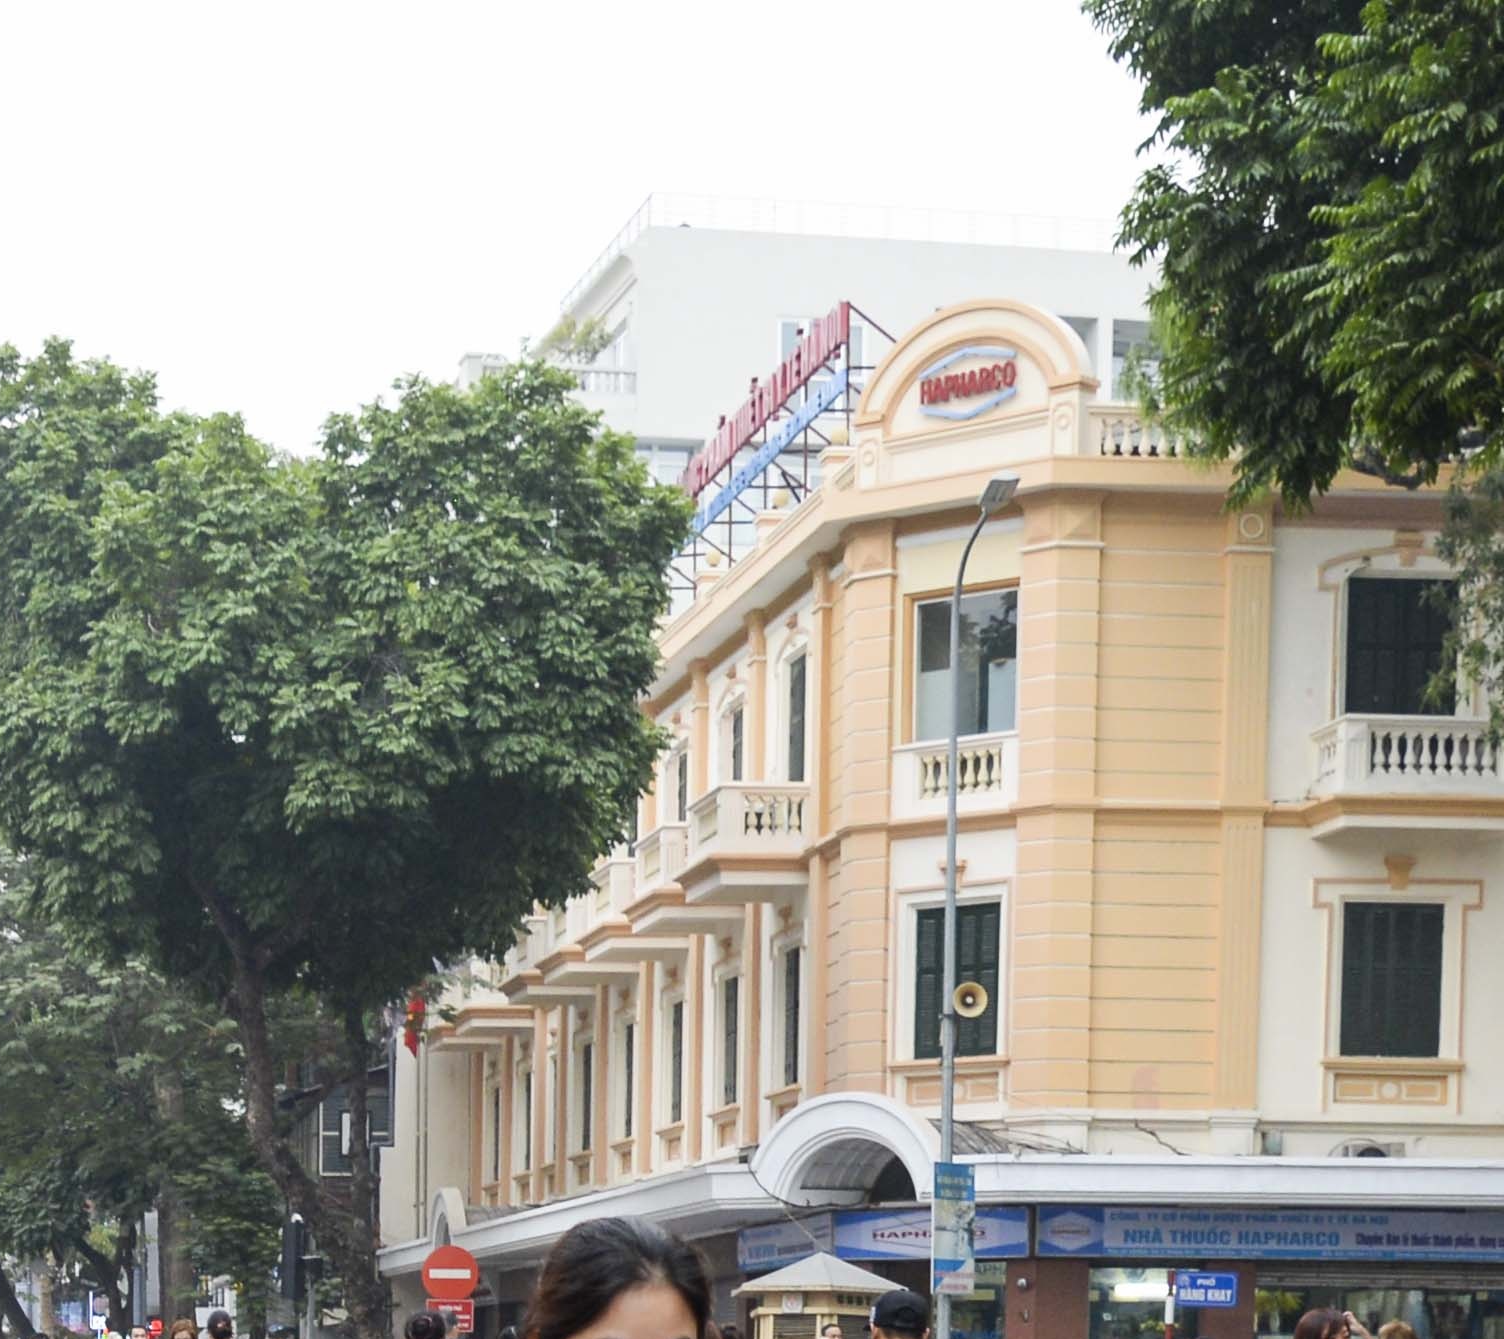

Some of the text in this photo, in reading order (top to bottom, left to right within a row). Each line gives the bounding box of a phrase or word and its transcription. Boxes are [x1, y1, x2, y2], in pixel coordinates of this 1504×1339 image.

[920, 360, 1017, 405] HAPHARCO
[1123, 1225, 1340, 1247] NHÀ THUỐC HAPHARCO
